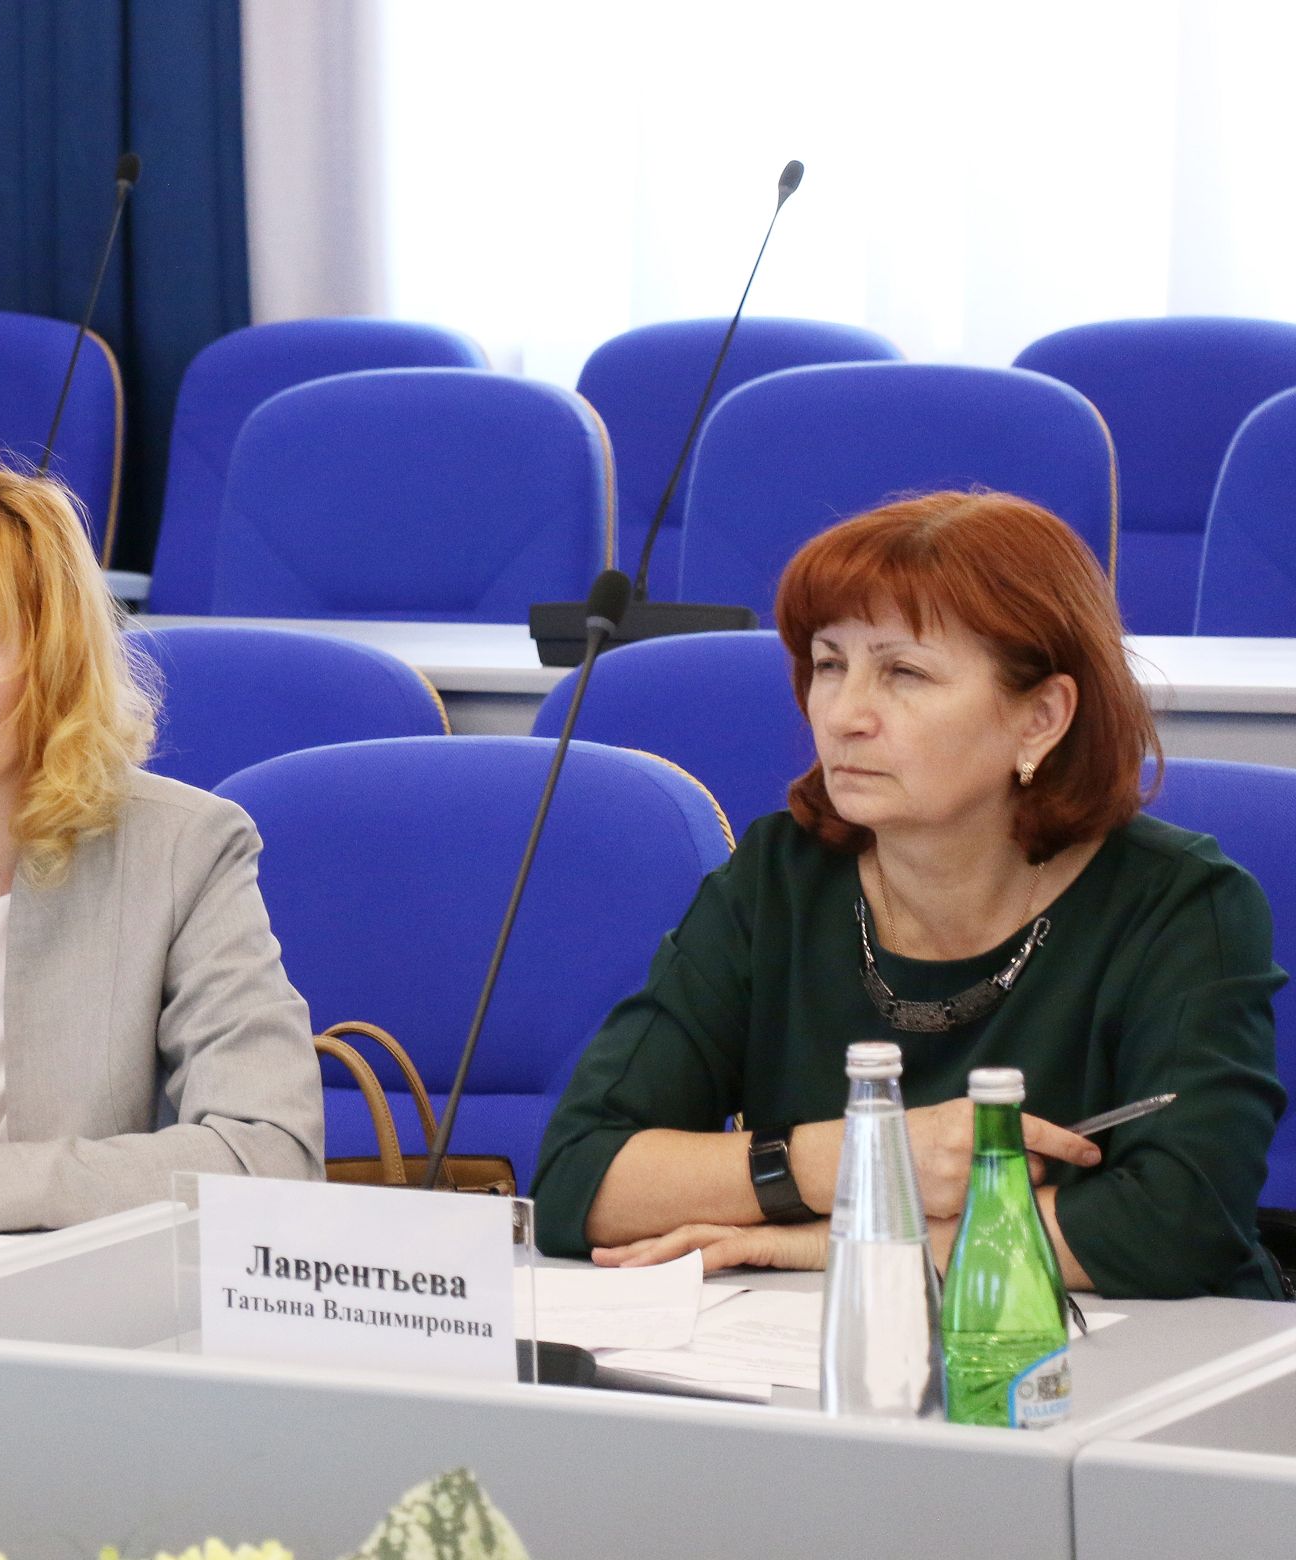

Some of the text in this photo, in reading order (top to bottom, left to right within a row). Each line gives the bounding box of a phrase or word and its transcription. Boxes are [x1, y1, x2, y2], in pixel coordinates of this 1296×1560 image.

[245, 1245, 467, 1299] Лаврентьева
[222, 1287, 493, 1338] Татьяна Владимировна
